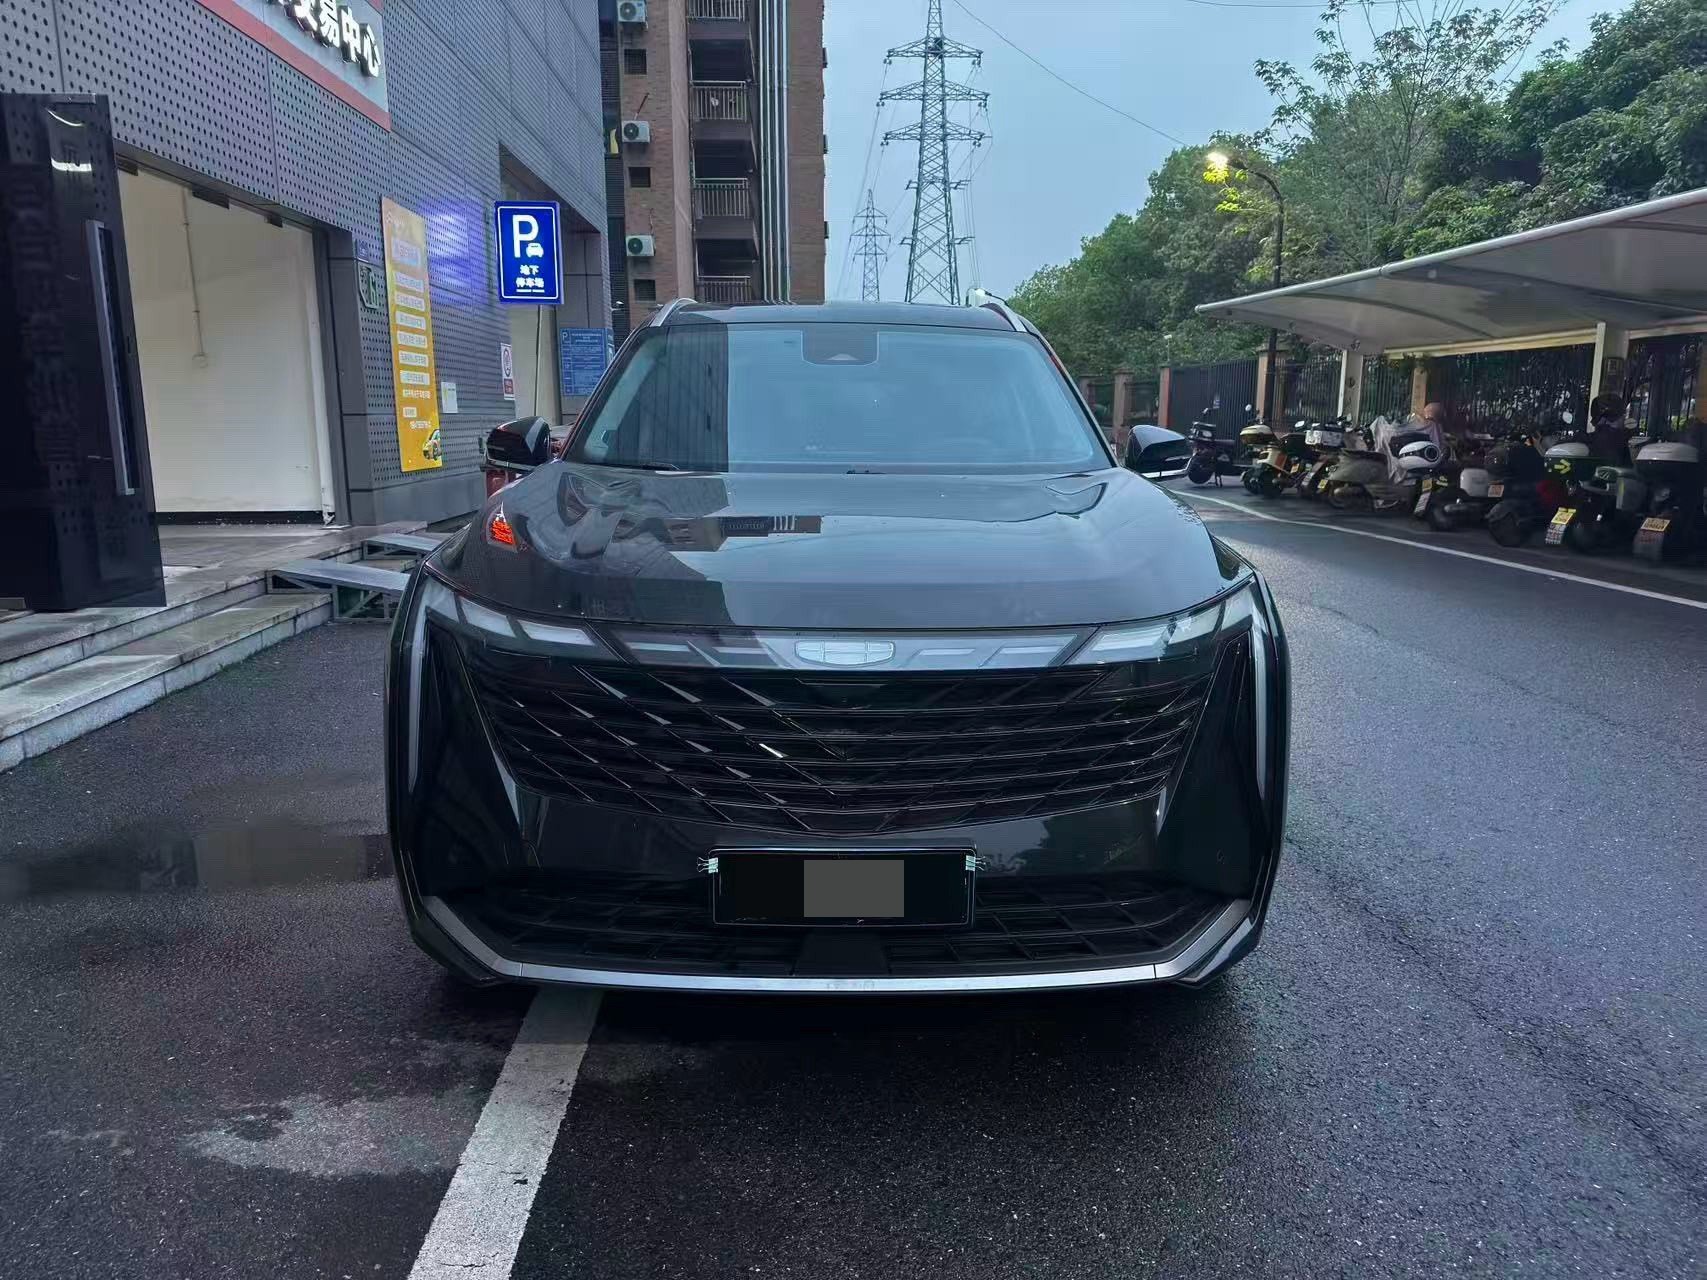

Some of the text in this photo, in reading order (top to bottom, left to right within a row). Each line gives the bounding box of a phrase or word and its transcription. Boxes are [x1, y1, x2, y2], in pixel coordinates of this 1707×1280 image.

[278, 0, 381, 77] 交易中心
[512, 214, 539, 258] P
